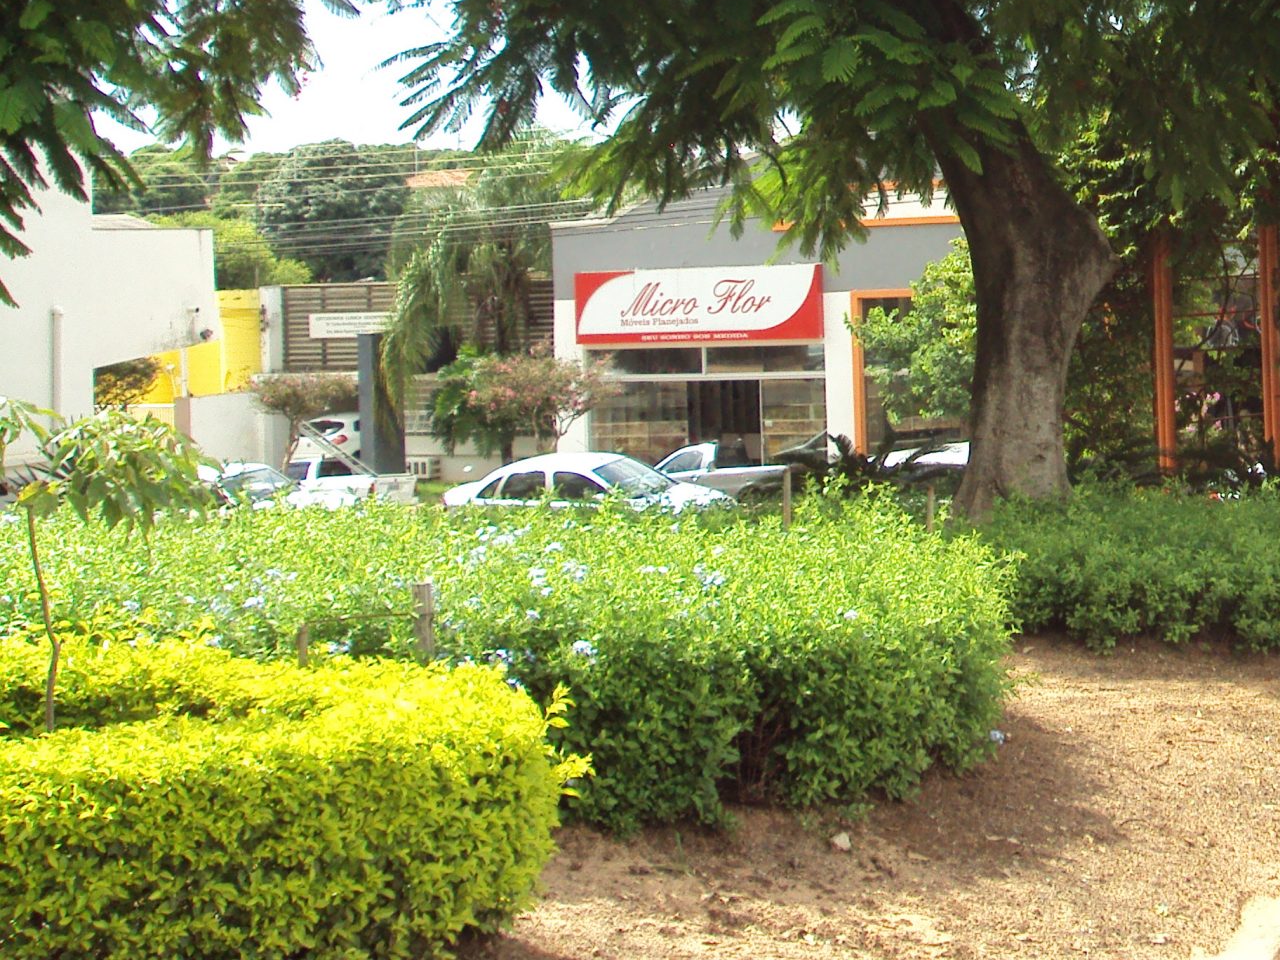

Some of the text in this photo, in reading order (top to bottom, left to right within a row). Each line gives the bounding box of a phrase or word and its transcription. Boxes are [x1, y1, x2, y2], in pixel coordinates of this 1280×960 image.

[620, 279, 771, 317] Micro Flor
[620, 317, 699, 327] Móveis Planejados
